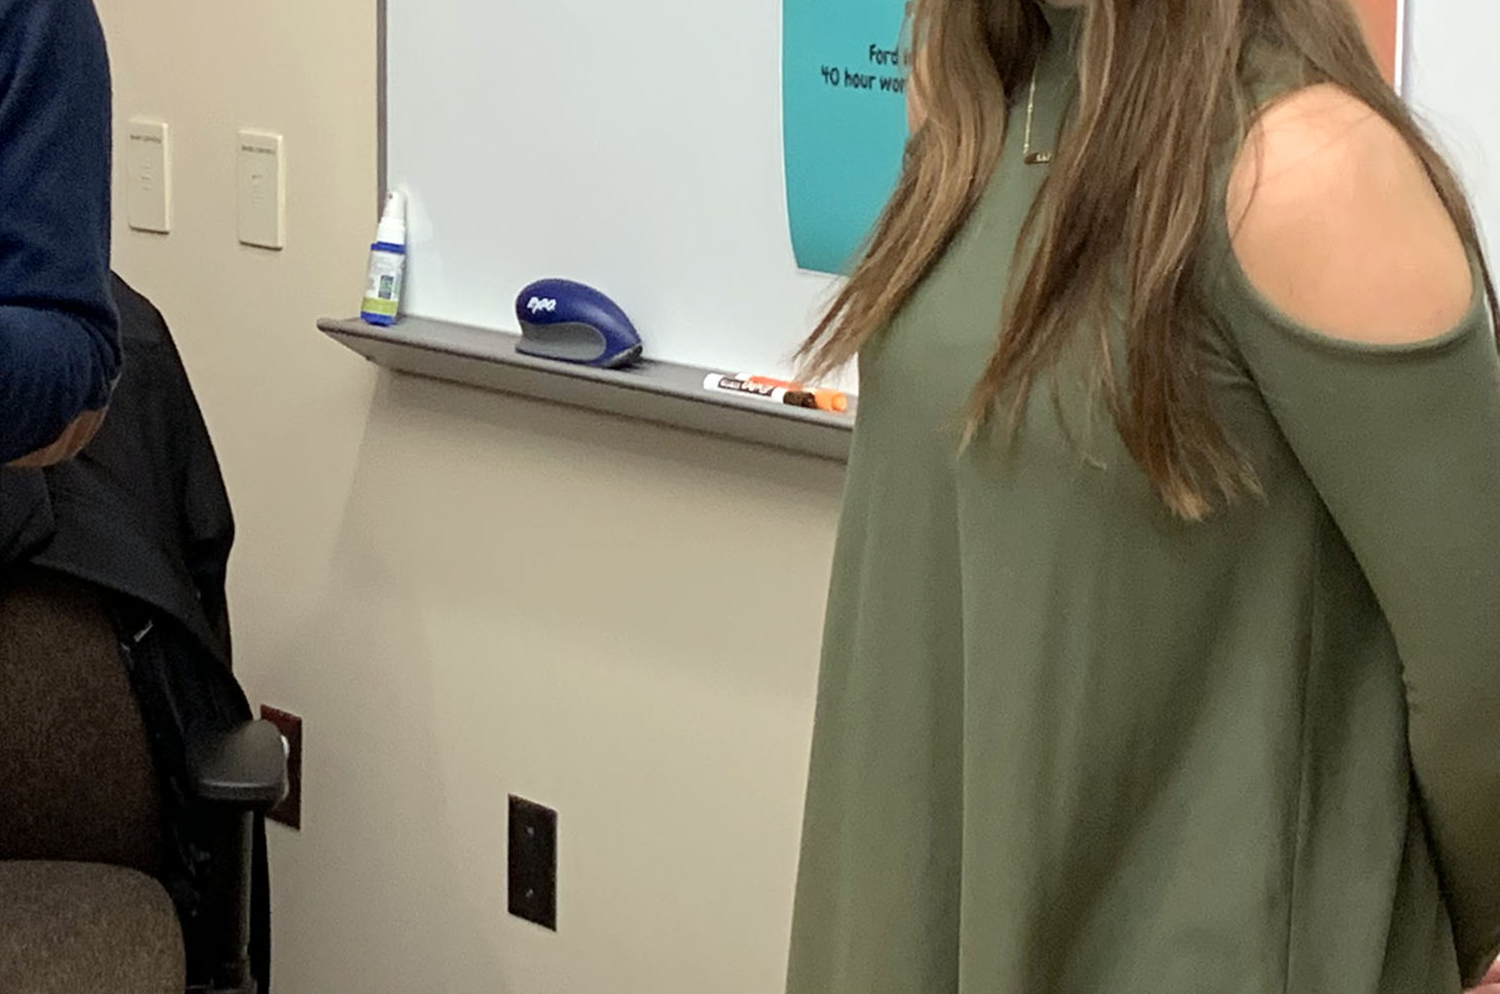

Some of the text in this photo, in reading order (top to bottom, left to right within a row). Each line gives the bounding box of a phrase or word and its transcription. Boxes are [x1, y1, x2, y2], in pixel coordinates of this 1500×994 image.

[868, 43, 899, 65] Ford
[820, 64, 840, 86] 40
[844, 67, 876, 90] hour
